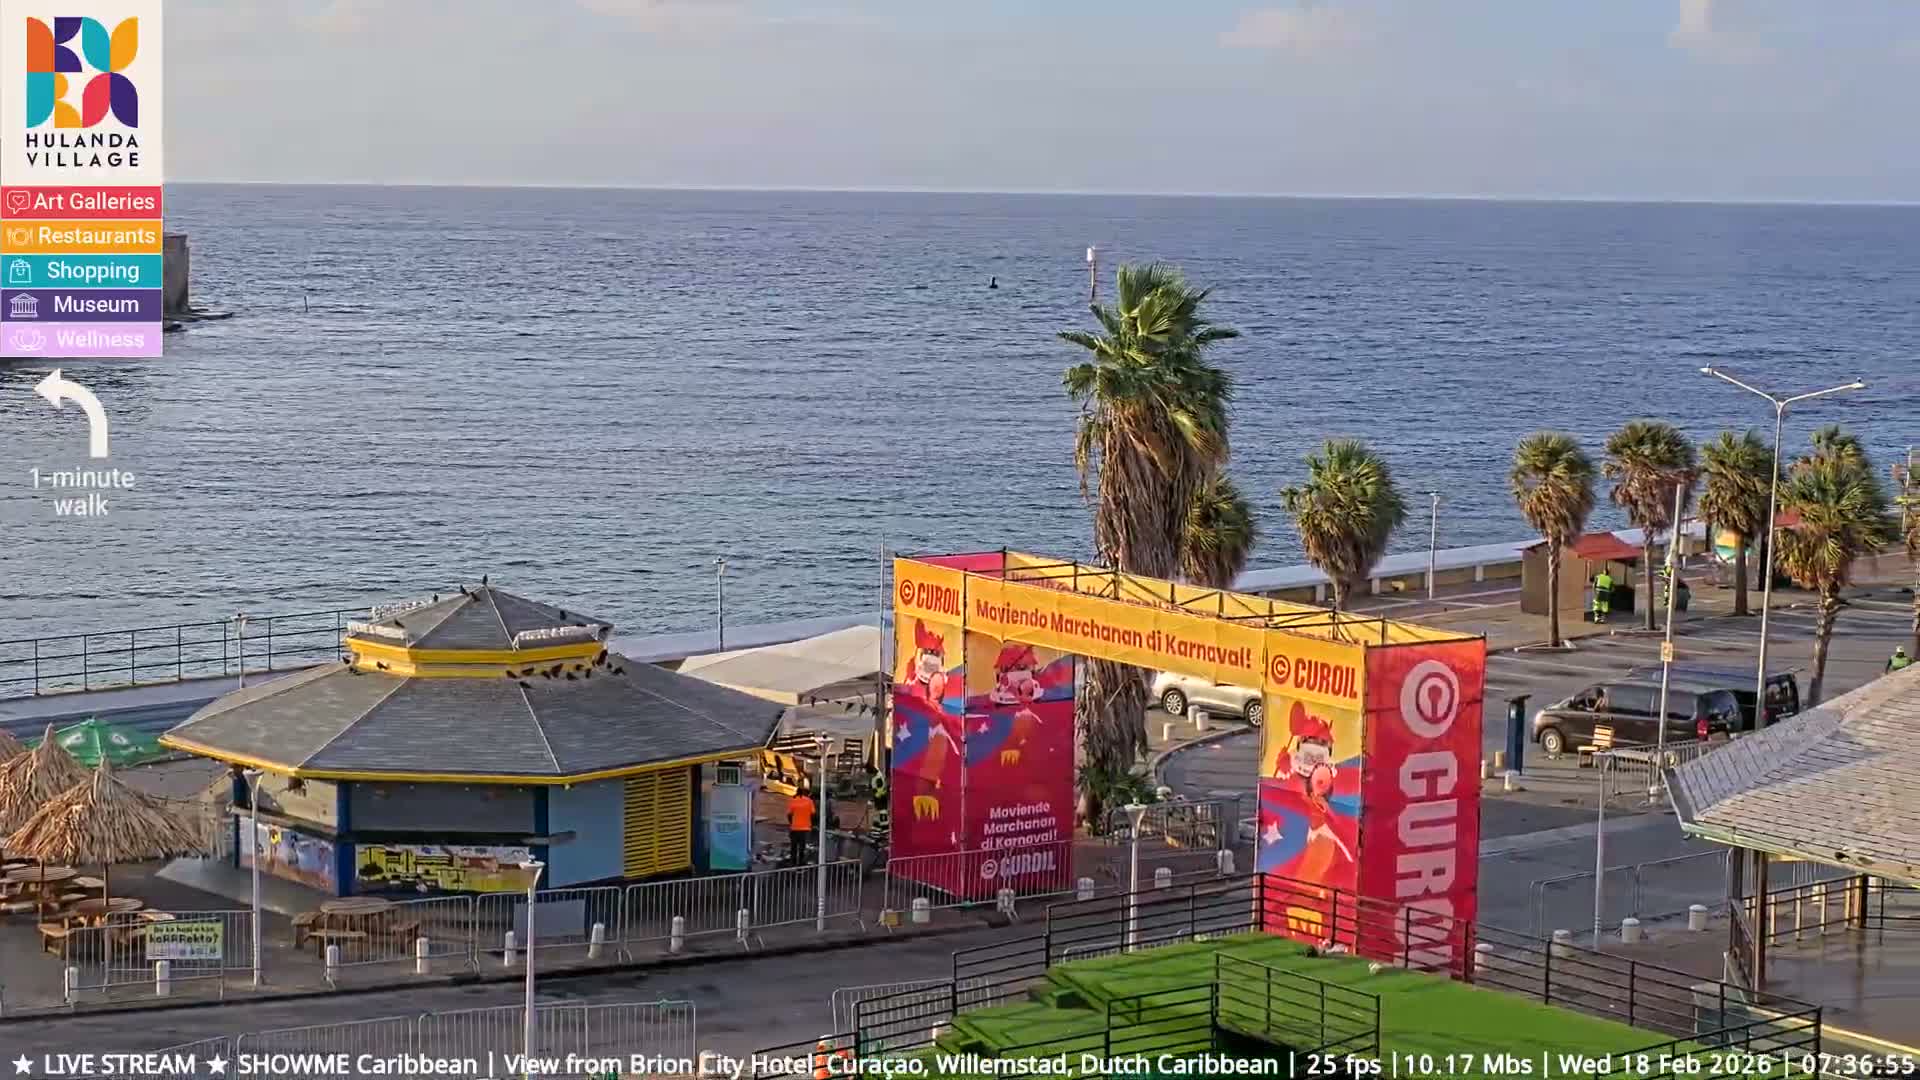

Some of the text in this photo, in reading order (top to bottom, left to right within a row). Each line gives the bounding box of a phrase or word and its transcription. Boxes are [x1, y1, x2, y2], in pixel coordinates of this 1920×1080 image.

[916, 582, 961, 617] CUROIL
[976, 598, 1252, 669] Moviendo Marchanan di Karnaval!
[1294, 657, 1358, 700] CUROIL
[990, 802, 1050, 819] Moviendo
[981, 829, 1057, 850] di Karnaval!
[984, 817, 1056, 836] Marchanan
[1001, 851, 1056, 877] CUROIL
